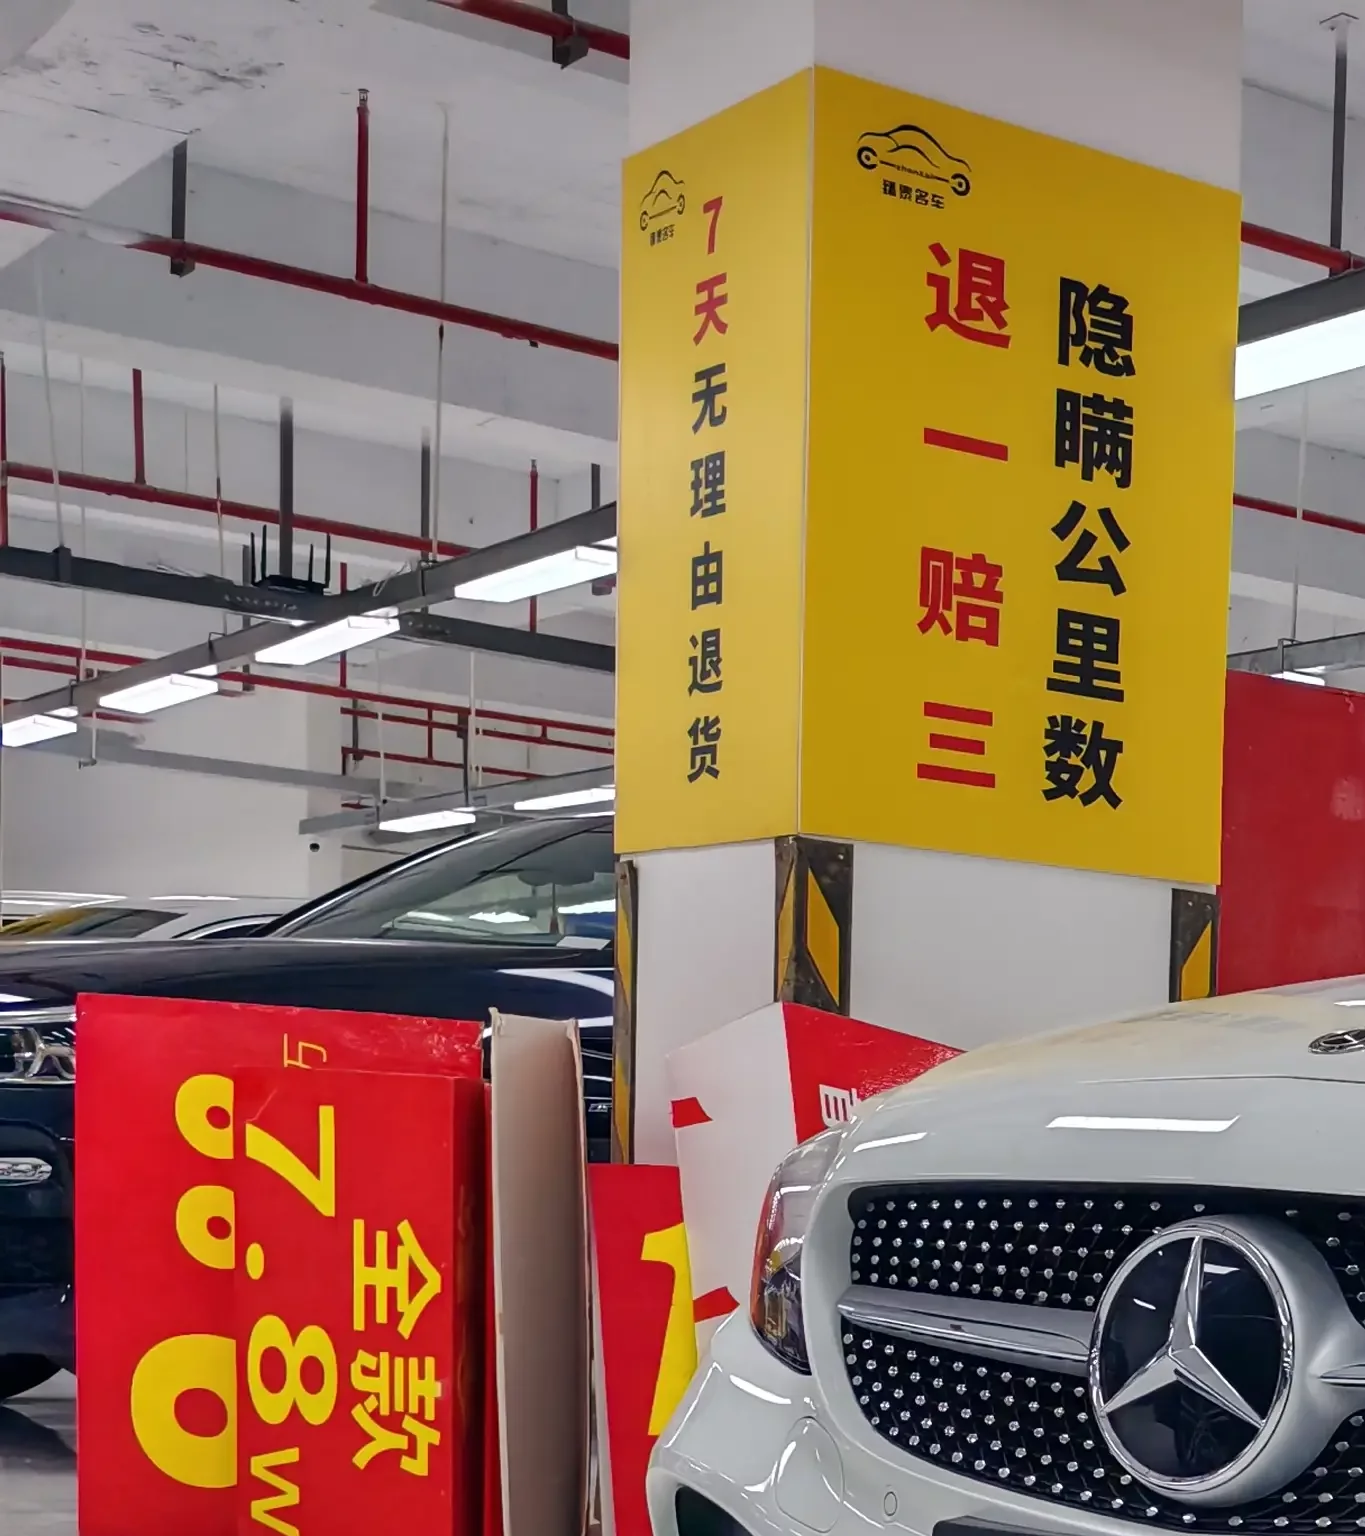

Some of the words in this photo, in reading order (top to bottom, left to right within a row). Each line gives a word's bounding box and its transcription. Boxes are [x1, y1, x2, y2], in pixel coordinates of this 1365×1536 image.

[687, 196, 728, 784] 7天无理由退货
[917, 242, 1012, 789] 退一赔三
[1042, 275, 1136, 810] 隐瞒公里数
[350, 1218, 443, 1477] 全款
